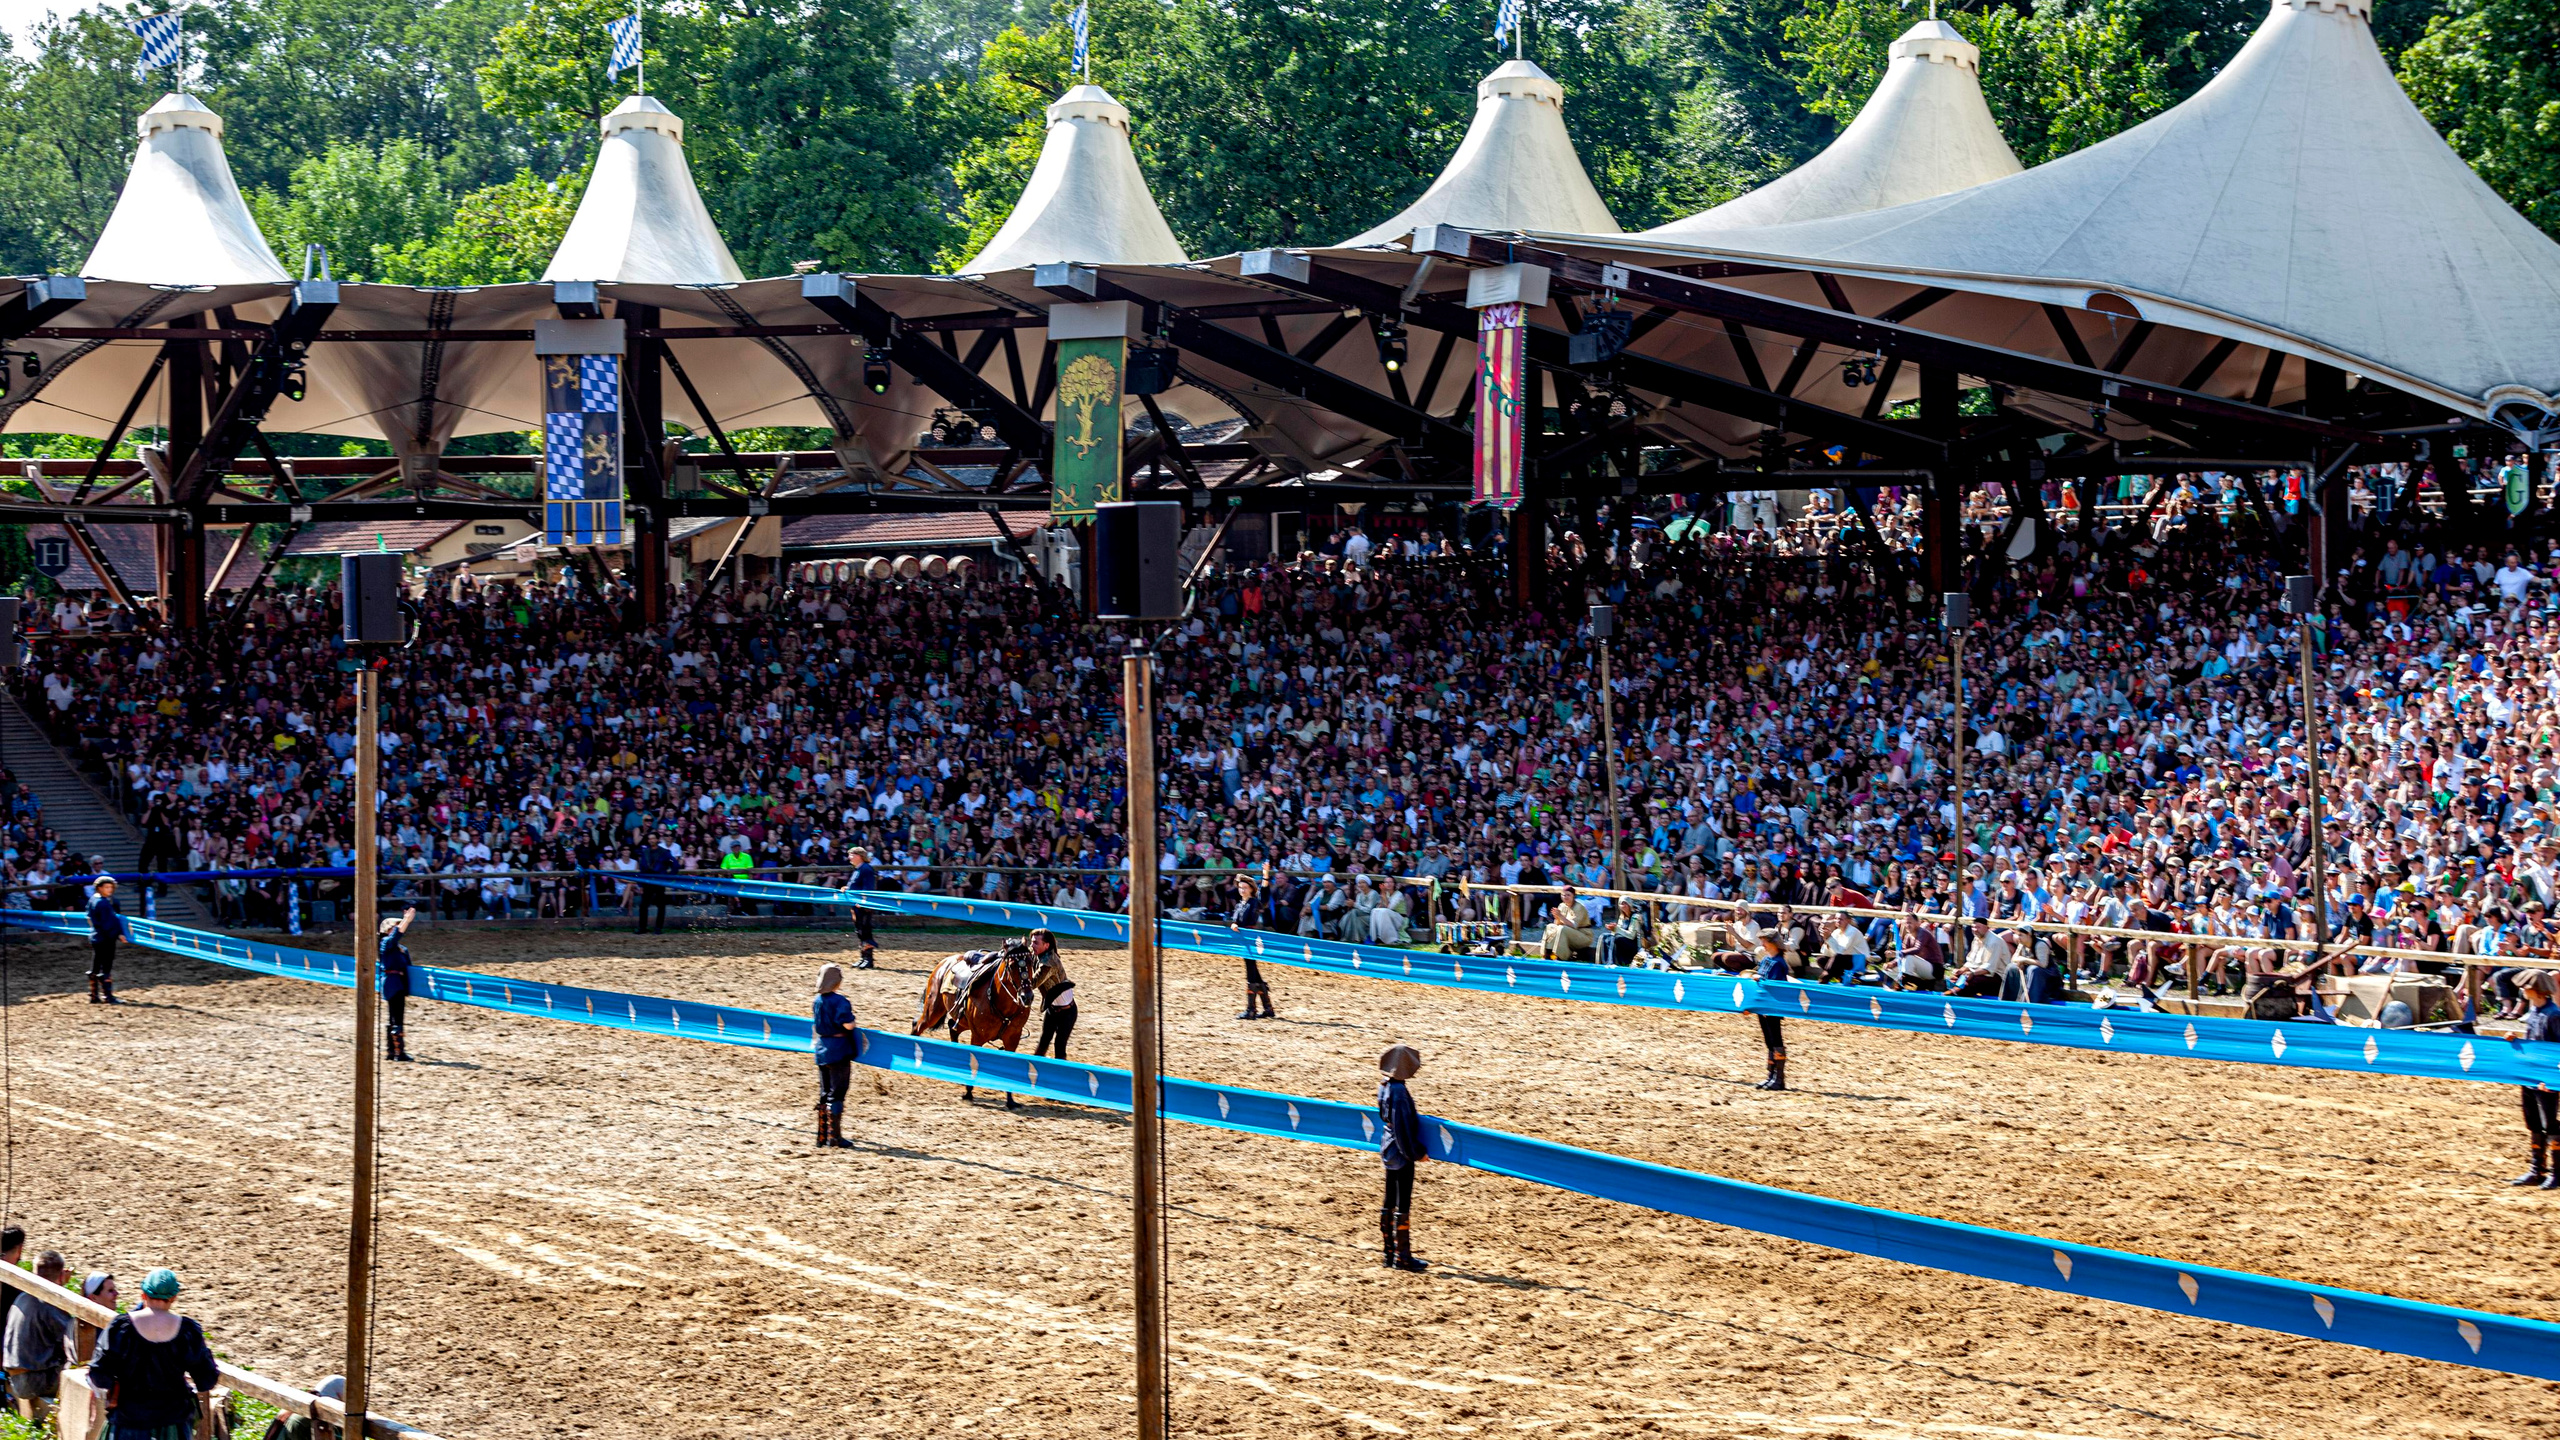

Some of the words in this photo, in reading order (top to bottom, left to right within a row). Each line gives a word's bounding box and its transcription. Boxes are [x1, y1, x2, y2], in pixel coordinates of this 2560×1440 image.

[2377, 484, 2393, 512] H
[2508, 473, 2526, 505] G
[38, 542, 66, 567] H
